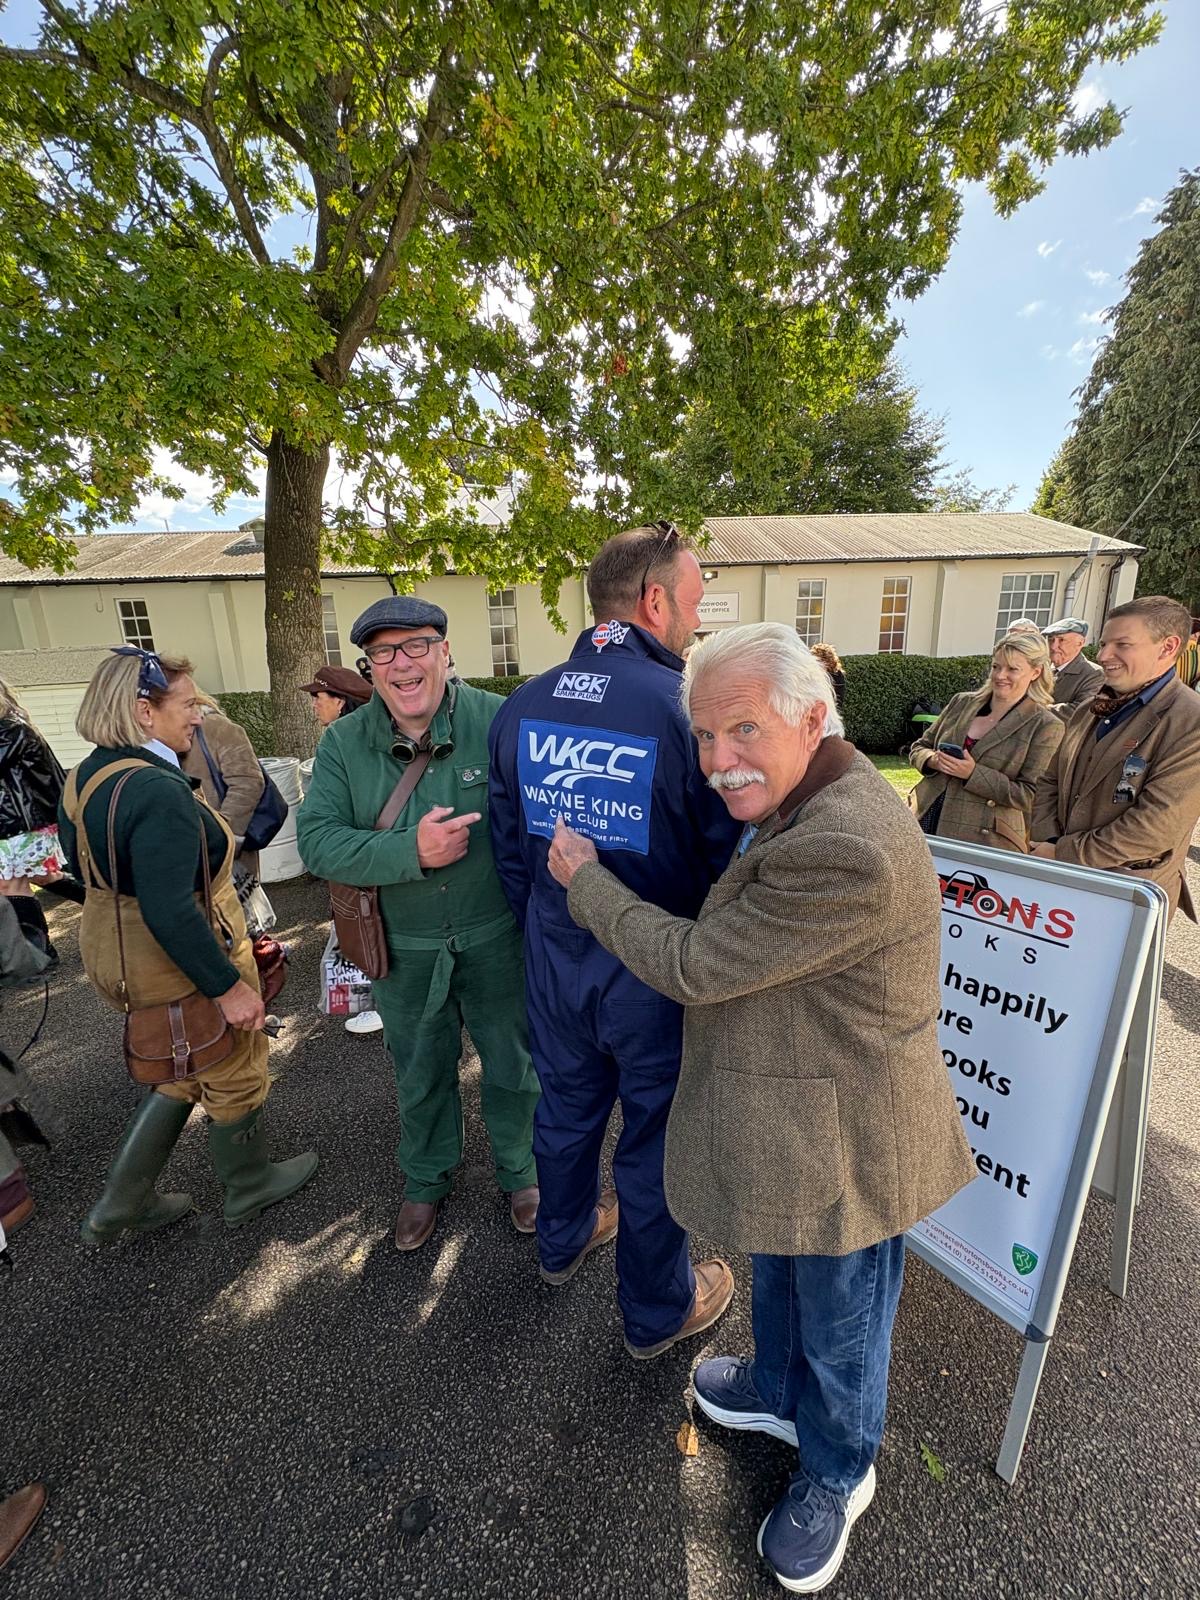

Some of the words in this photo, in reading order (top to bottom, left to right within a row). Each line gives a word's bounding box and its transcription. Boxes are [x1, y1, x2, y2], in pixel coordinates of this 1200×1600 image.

[559, 674, 606, 693] NGK
[578, 693, 601, 701] PLUGS
[529, 731, 648, 779] WKCC
[524, 785, 585, 809] WAYNE
[591, 796, 643, 820] KING
[577, 813, 608, 830] CLUB
[590, 830, 607, 842] COME
[609, 835, 629, 843] FIRST
[948, 923, 1037, 964] OKS
[944, 963, 1068, 1033] happily
[942, 1049, 1012, 1096] ooks
[956, 1096, 990, 1130] ou
[971, 1147, 1031, 1198] ent
[926, 1228, 939, 1242] Fax:
[964, 1255, 980, 1271] 1672
[980, 1268, 1007, 1291] 514772
[931, 1224, 1029, 1297] contact@hortonsbooks.co.uk
